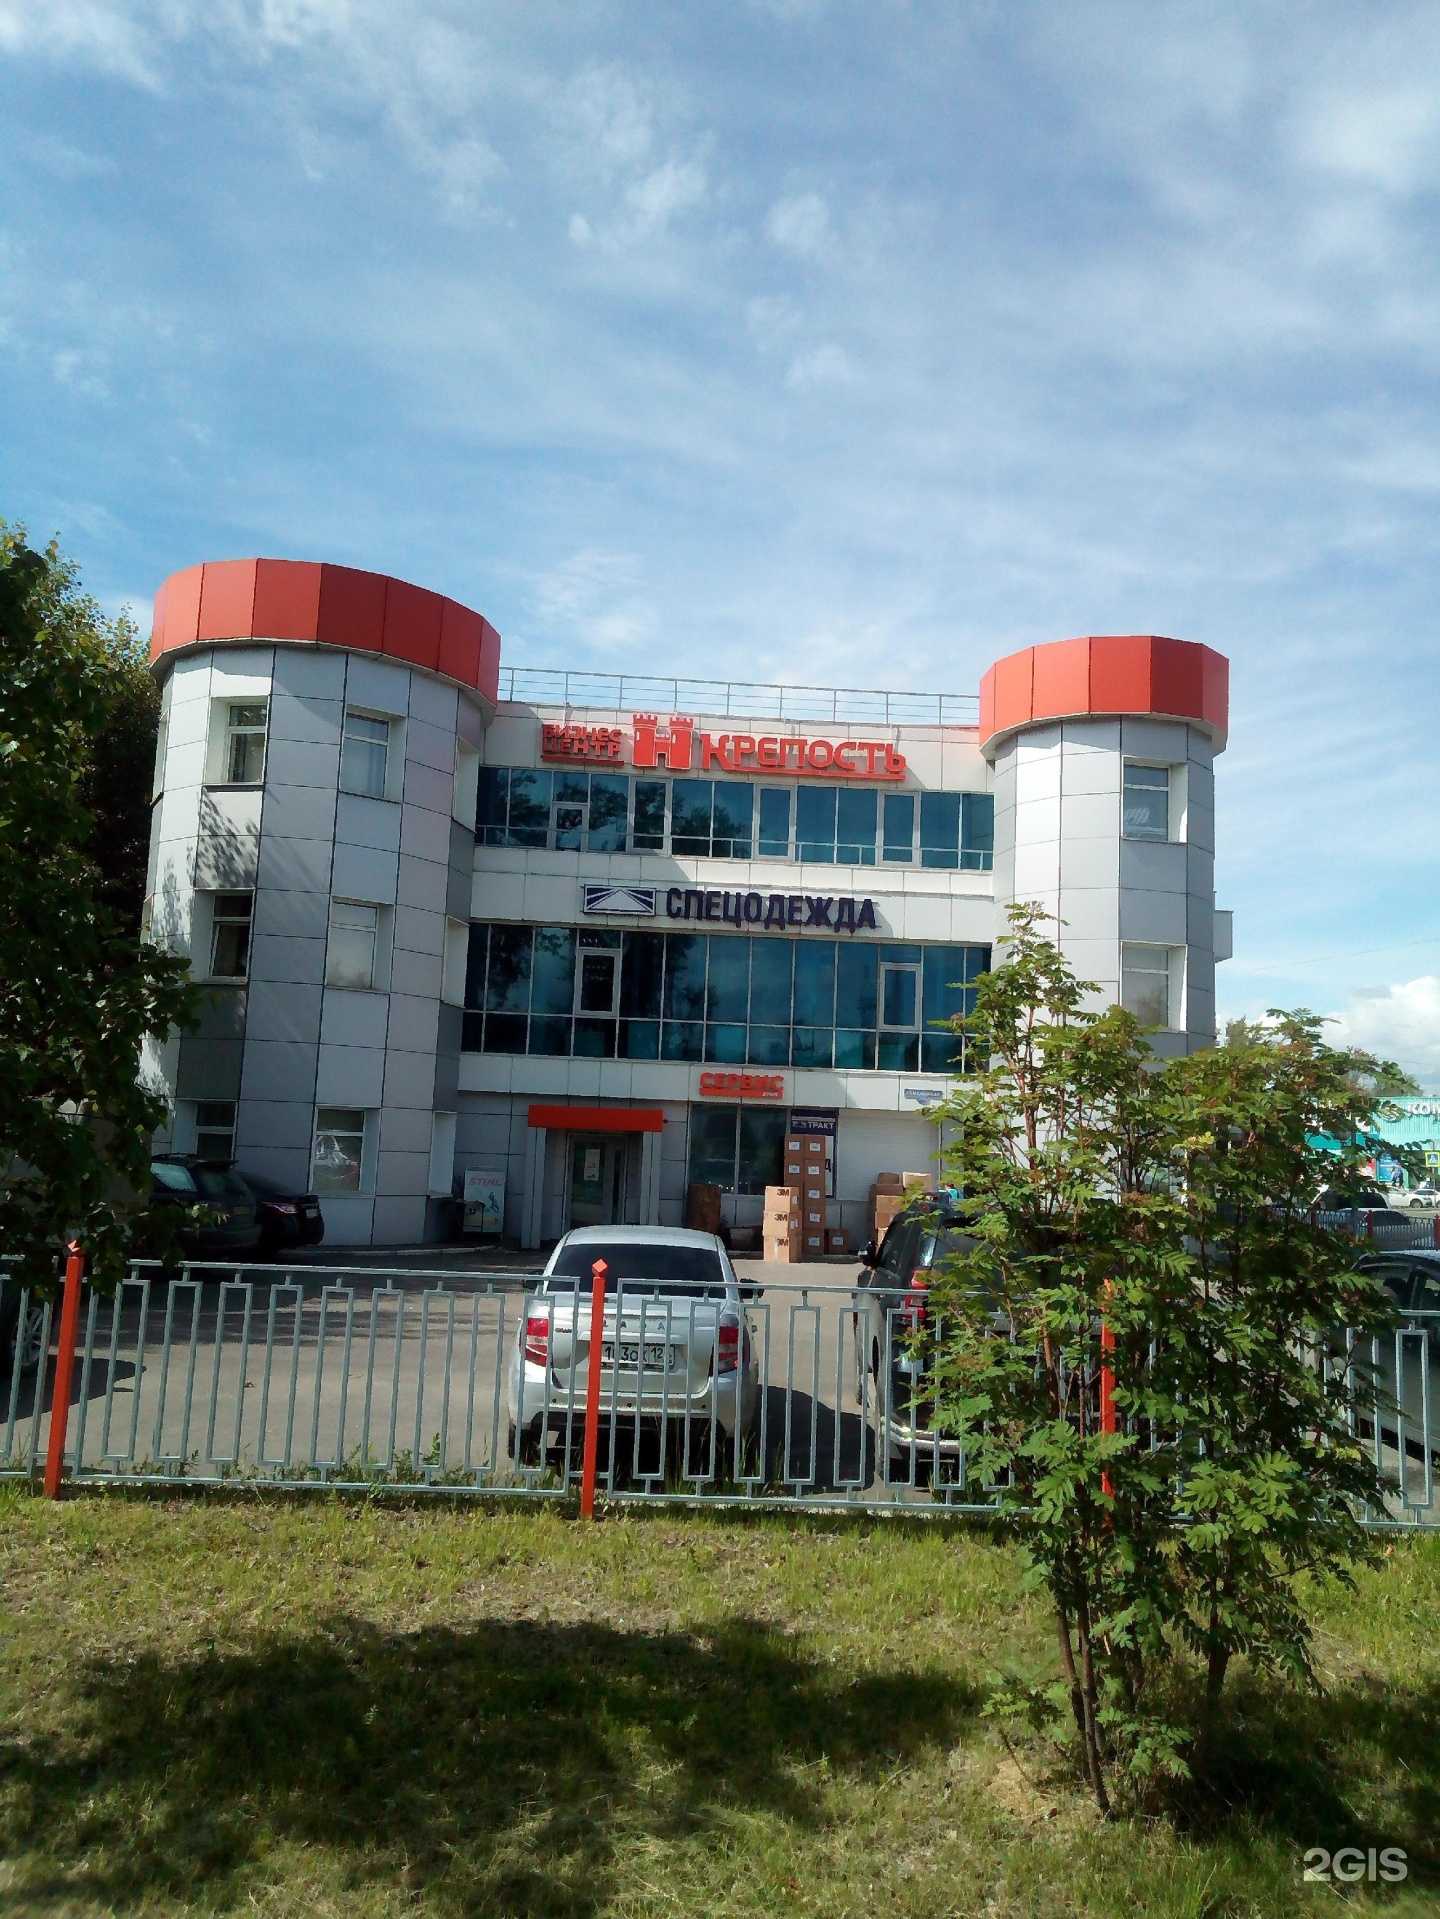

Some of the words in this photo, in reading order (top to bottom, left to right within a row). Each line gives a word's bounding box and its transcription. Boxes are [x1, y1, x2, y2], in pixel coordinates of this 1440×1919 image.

[543, 724, 622, 742] БИЗНЕС
[543, 738, 621, 757] ЦЕНТР
[701, 733, 907, 776] КРЕПОСТЬ
[665, 887, 878, 933] СПЕЦОДЕЖДА
[700, 1072, 784, 1090] СЕРВИС
[776, 1188, 790, 1197] 3M
[774, 1213, 788, 1222] 3M
[603, 1320, 665, 1330] LAA
